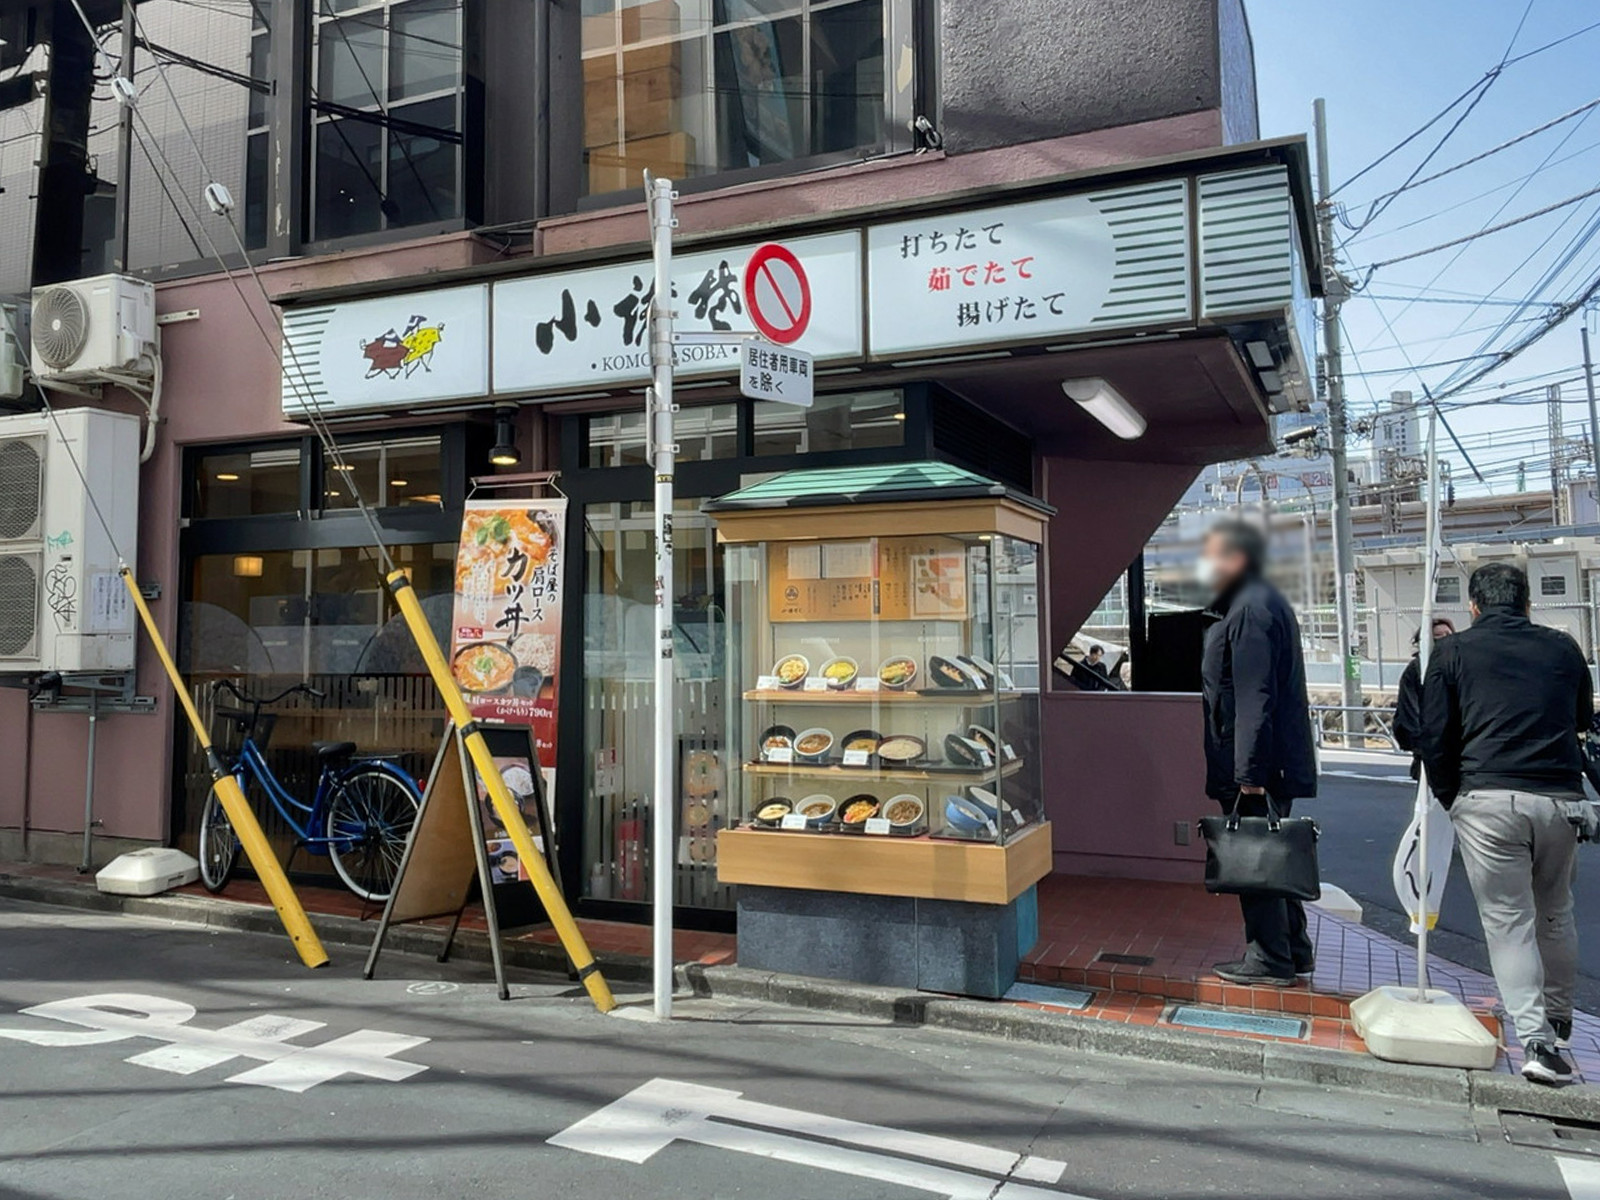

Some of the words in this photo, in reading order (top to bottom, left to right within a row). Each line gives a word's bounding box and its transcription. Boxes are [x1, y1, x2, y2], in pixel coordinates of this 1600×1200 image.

[900, 222, 1005, 259] 打ちたて
[928, 256, 1035, 293] 茹でたて
[957, 292, 1066, 327] 揚げたて
[603, 350, 677, 372] KOMO
[681, 344, 728, 363] SOBA
[749, 347, 808, 377] 居住者用車両
[749, 371, 783, 394] を除く
[531, 566, 545, 621] 肩ロース
[546, 549, 559, 603] そば屋の
[495, 547, 530, 645] カツ丼
